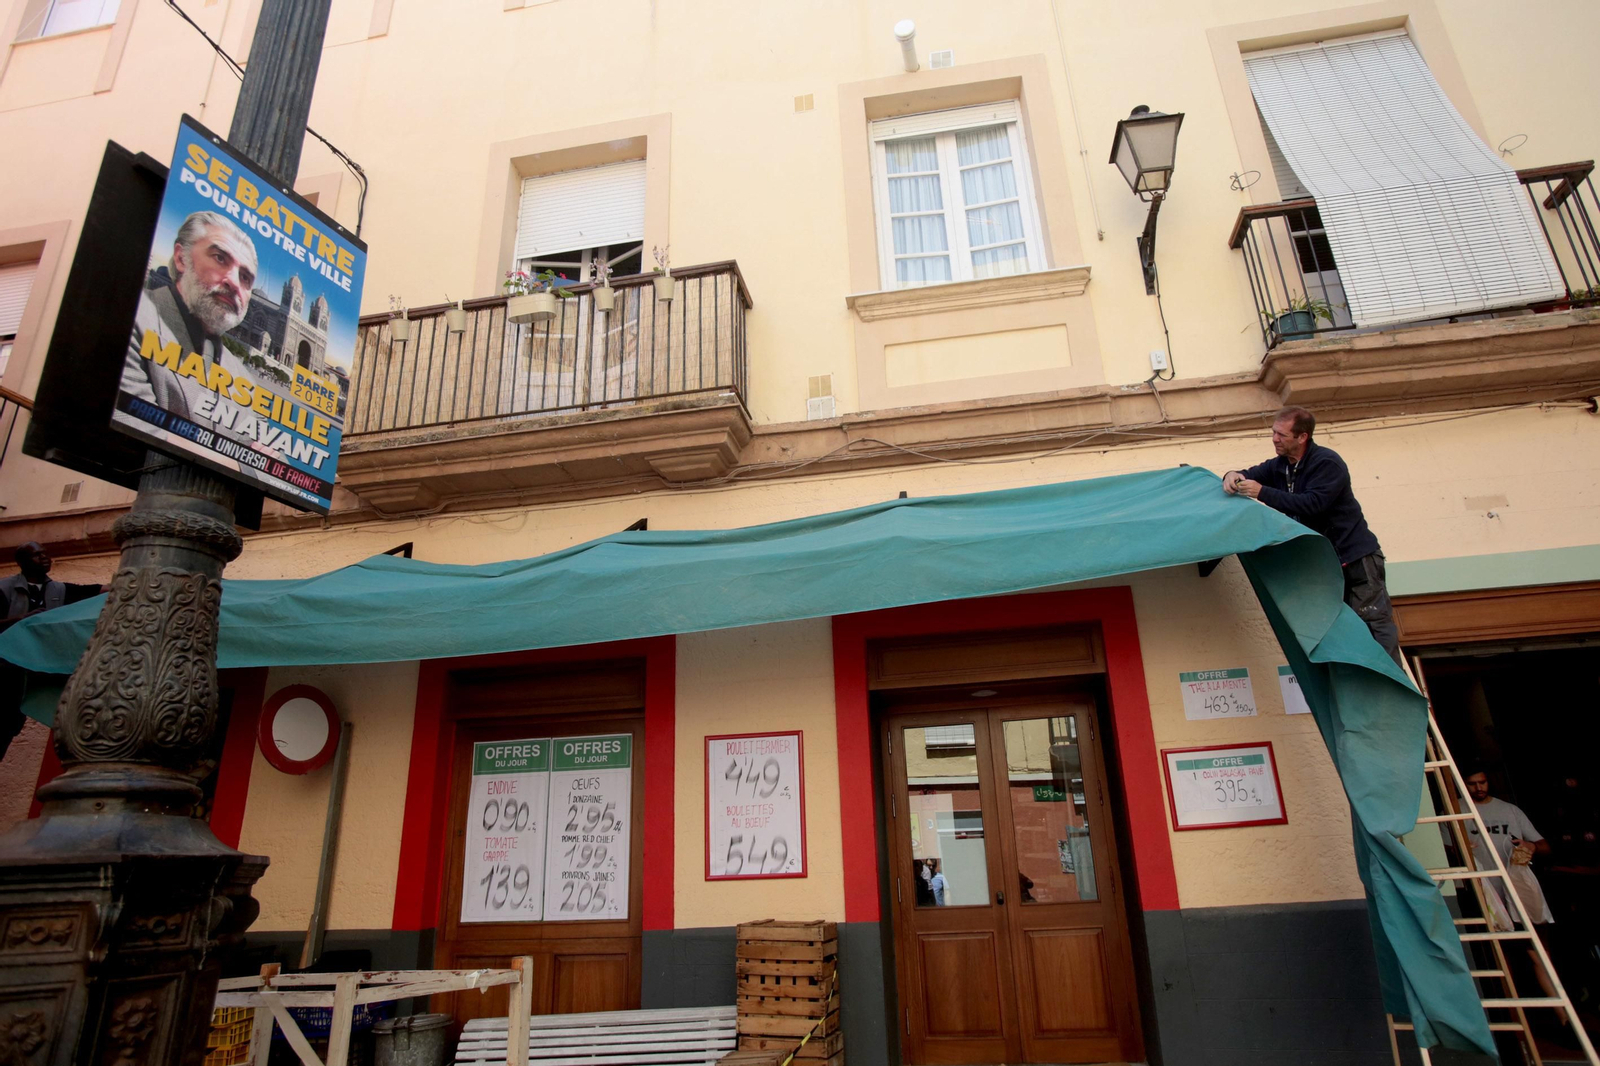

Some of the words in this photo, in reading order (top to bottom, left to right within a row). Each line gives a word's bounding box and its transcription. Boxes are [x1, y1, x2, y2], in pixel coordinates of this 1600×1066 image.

[185, 144, 232, 192] SE
[236, 176, 356, 276] BATTRE
[180, 167, 241, 220] POUR
[242, 208, 306, 262] NOTRE
[308, 252, 352, 292] VILLE
[140, 328, 332, 446] MARSEILLE
[296, 373, 336, 402] BARRE
[294, 384, 334, 413] 2018
[193, 391, 240, 430] EN
[236, 418, 330, 470] AVANT
[128, 399, 165, 425] PARTI
[216, 437, 270, 474] UNIVERSAL
[272, 462, 286, 478] DE
[286, 468, 322, 494] FRANCE
[1198, 670, 1228, 680] OFFRE
[1222, 679, 1247, 690] MENTE
[484, 744, 540, 760] OFFRES
[563, 740, 621, 756] OFFRES
[726, 740, 753, 756] POULET
[756, 739, 791, 756] FERMIER
[495, 760, 506, 768] DU
[1212, 757, 1244, 766] OFFRE
[487, 780, 518, 795] ENDIVE
[726, 804, 774, 816] BOULETTES
[731, 818, 741, 828] AU
[485, 836, 518, 849] TOMATE
[562, 835, 580, 843] POMME
[582, 835, 595, 843] RED
[596, 835, 615, 844] CHIEF
